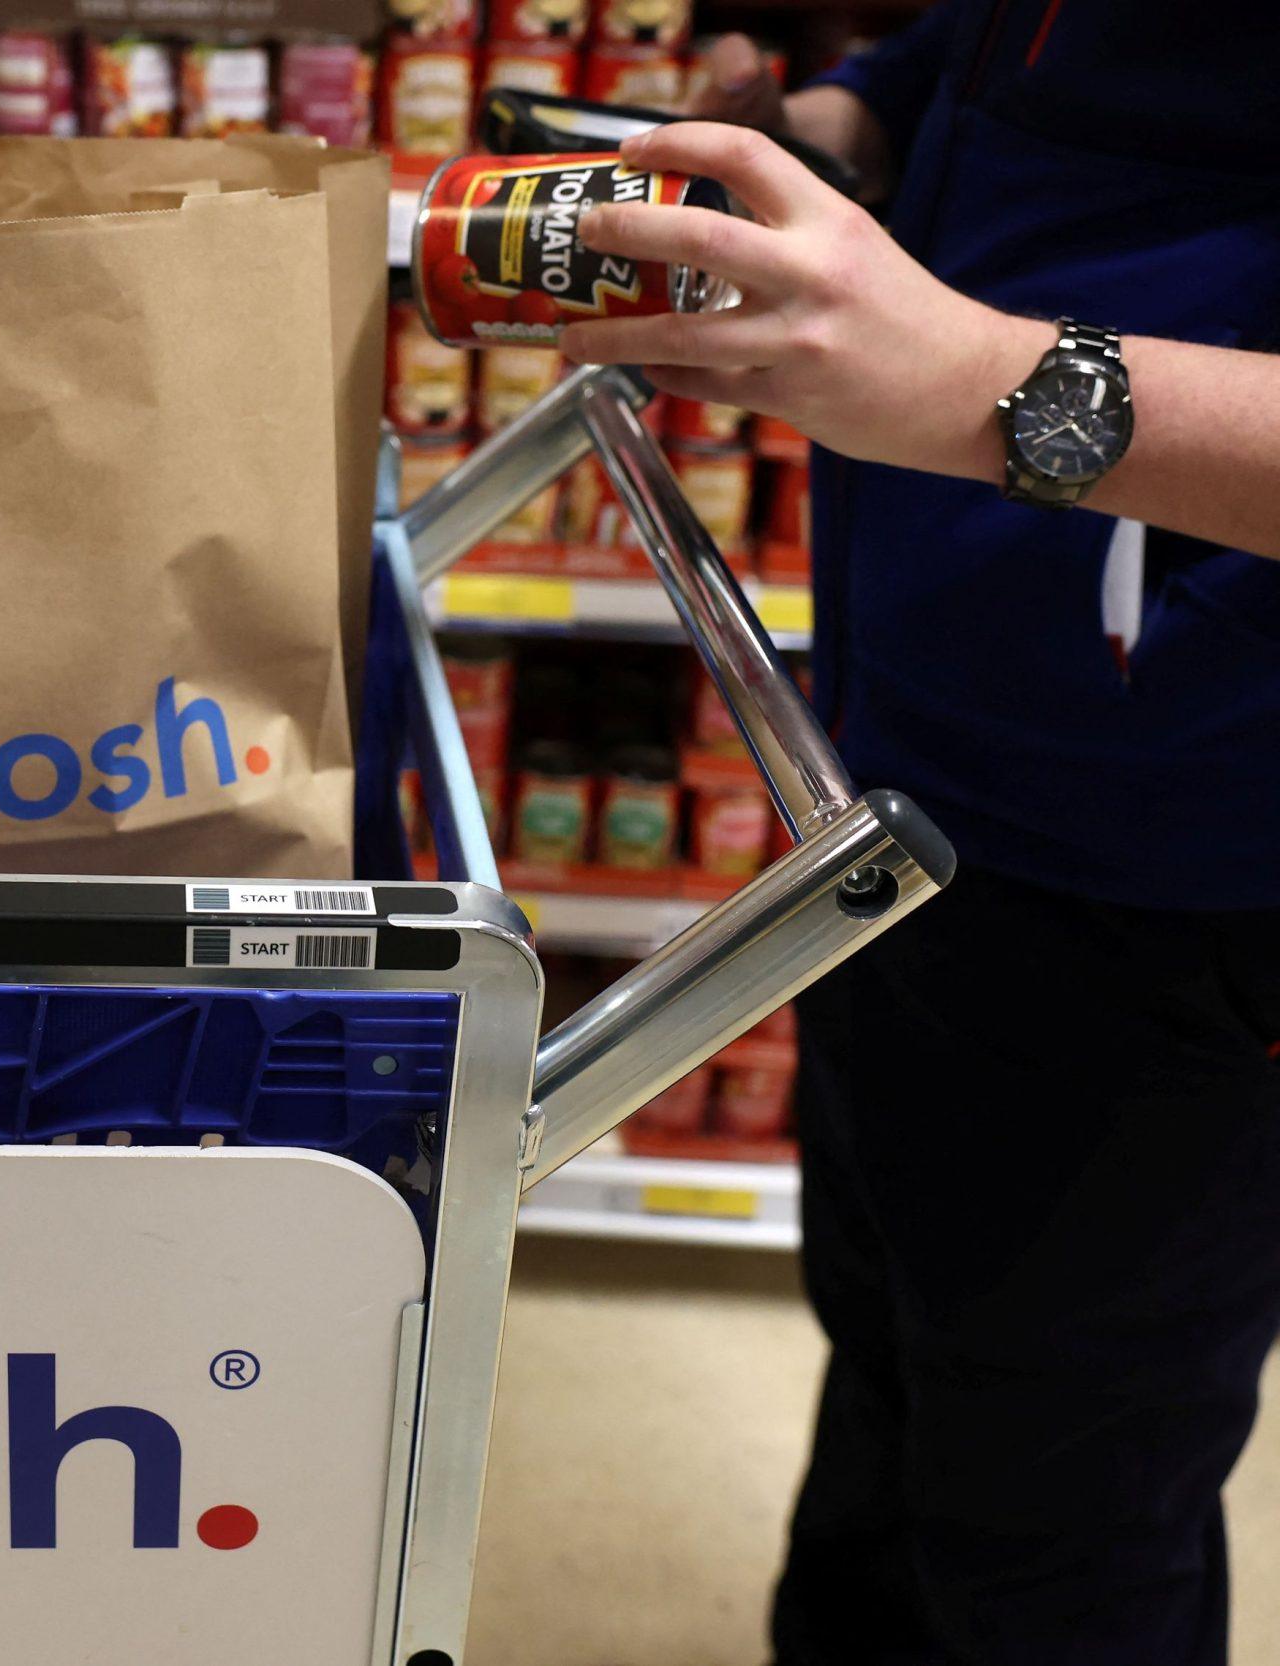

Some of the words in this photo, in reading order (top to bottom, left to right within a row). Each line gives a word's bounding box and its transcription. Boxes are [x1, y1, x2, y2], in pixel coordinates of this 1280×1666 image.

[540, 169, 593, 293] TOMATO
[240, 894, 288, 904] START
[240, 942, 290, 956] START
